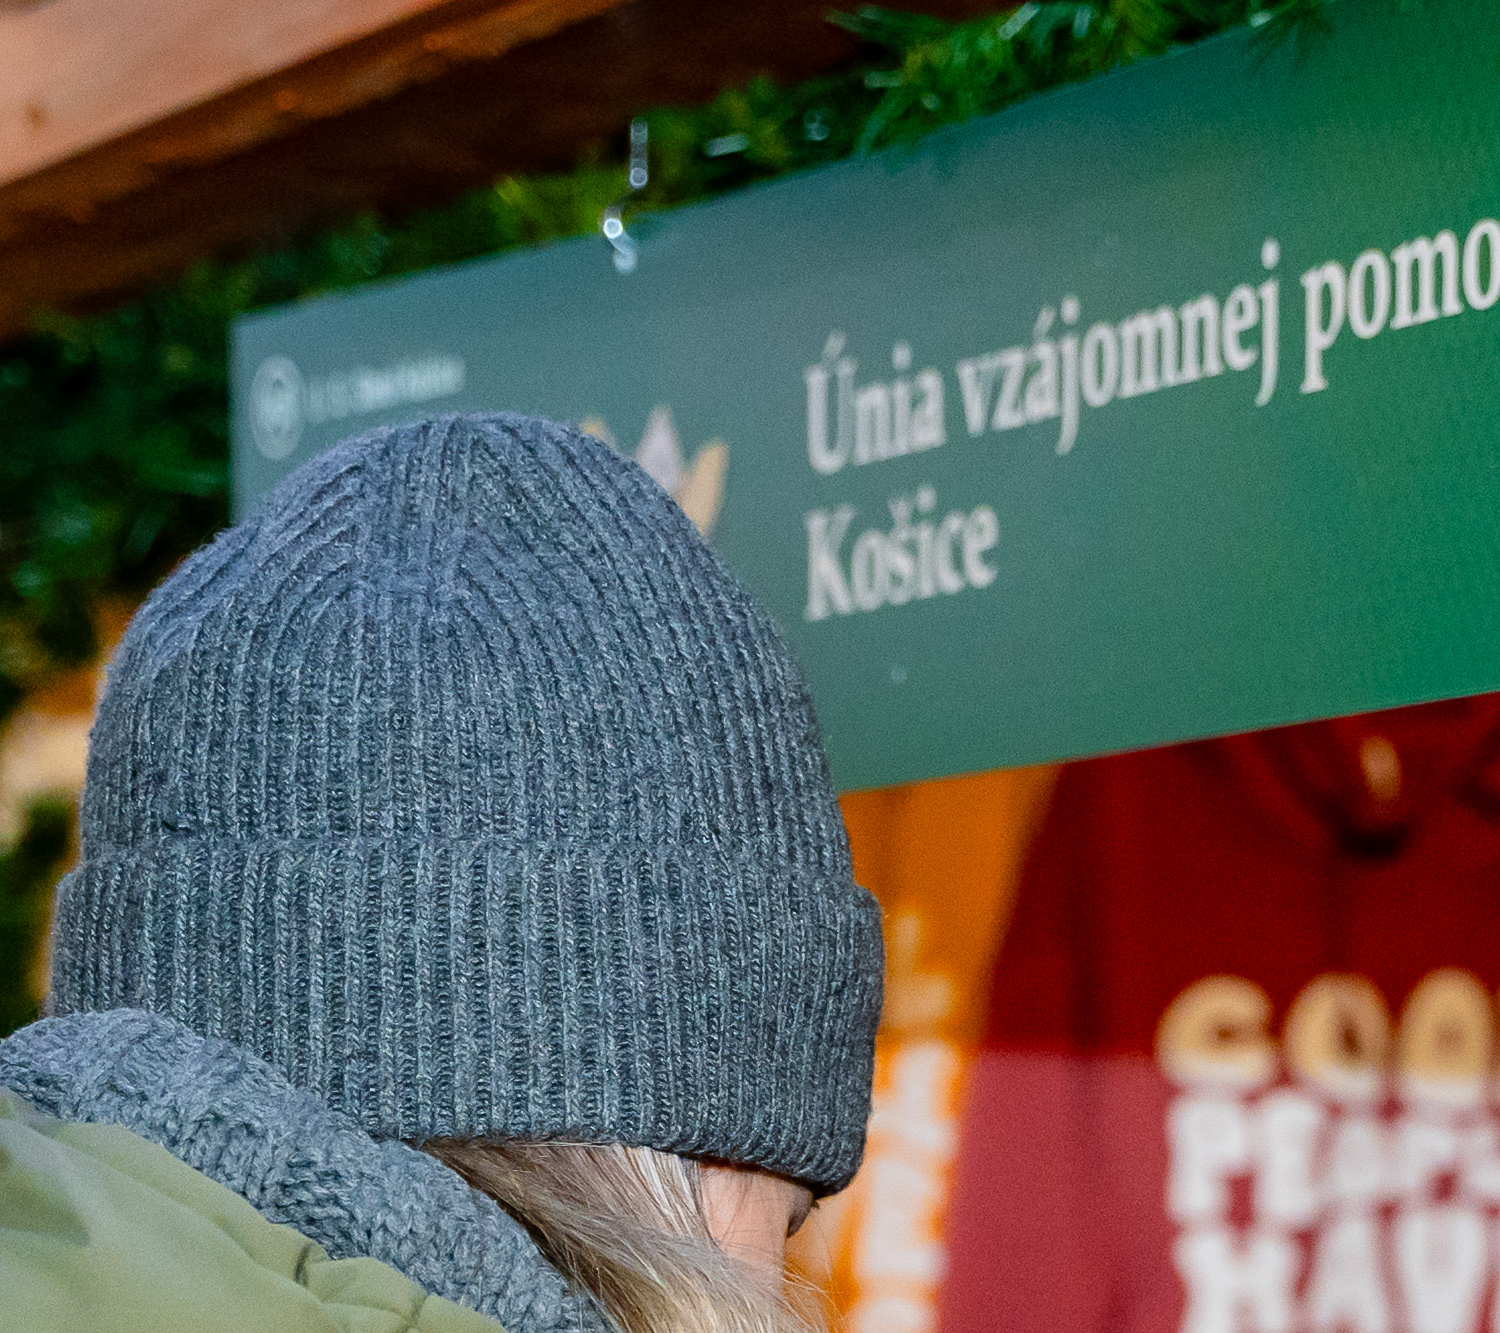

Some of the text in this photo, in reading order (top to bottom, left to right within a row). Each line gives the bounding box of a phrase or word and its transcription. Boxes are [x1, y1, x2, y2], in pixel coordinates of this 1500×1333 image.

[804, 330, 947, 474] Únia
[957, 237, 1282, 457] vzájomnej
[804, 485, 1000, 621] Košice
